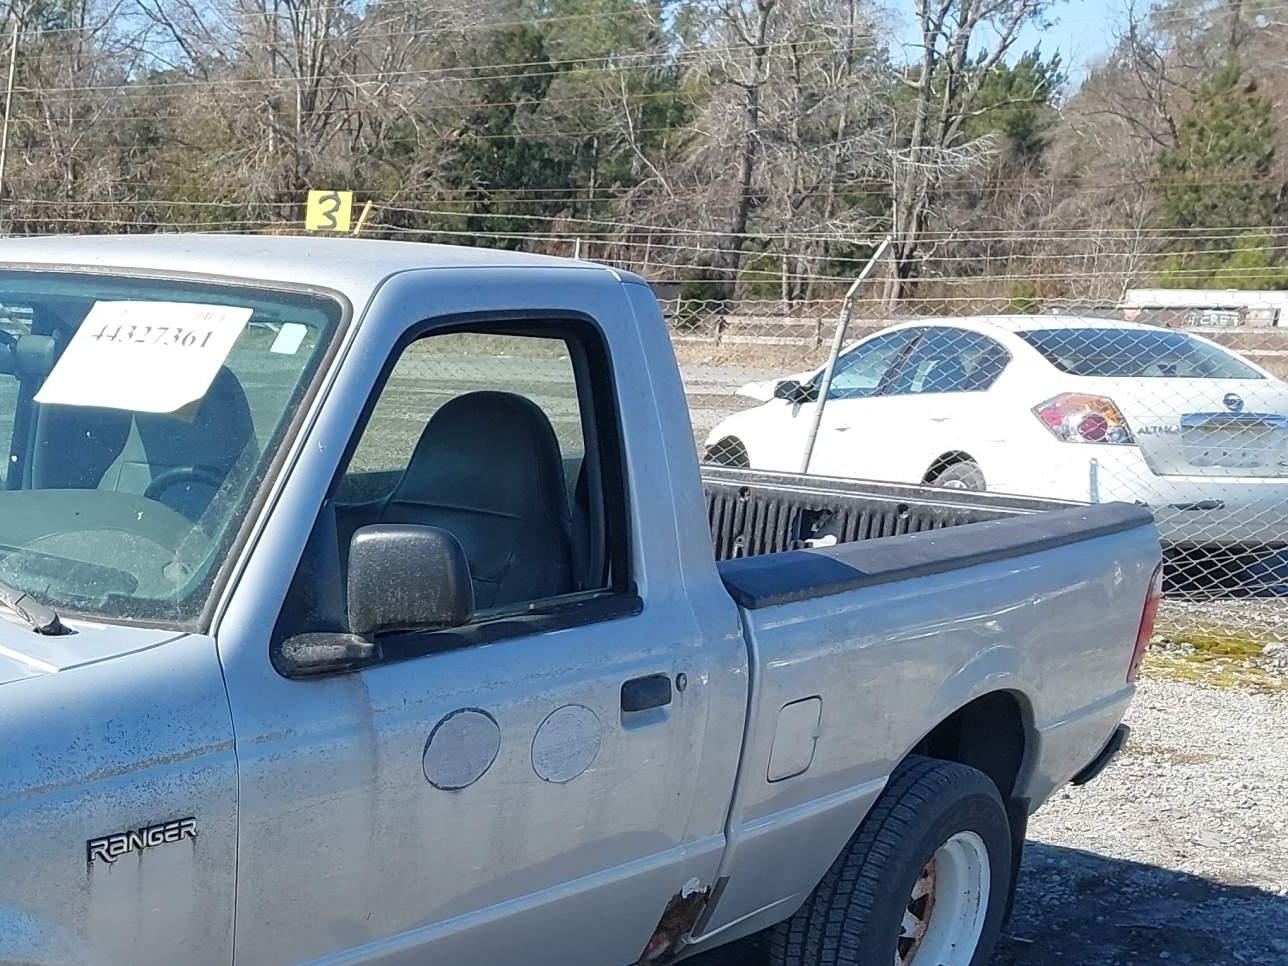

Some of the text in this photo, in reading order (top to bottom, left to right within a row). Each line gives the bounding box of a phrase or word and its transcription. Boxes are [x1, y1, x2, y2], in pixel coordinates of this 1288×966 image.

[317, 191, 341, 230] 3
[91, 324, 214, 348] 44327361
[87, 816, 199, 864] RANGER
